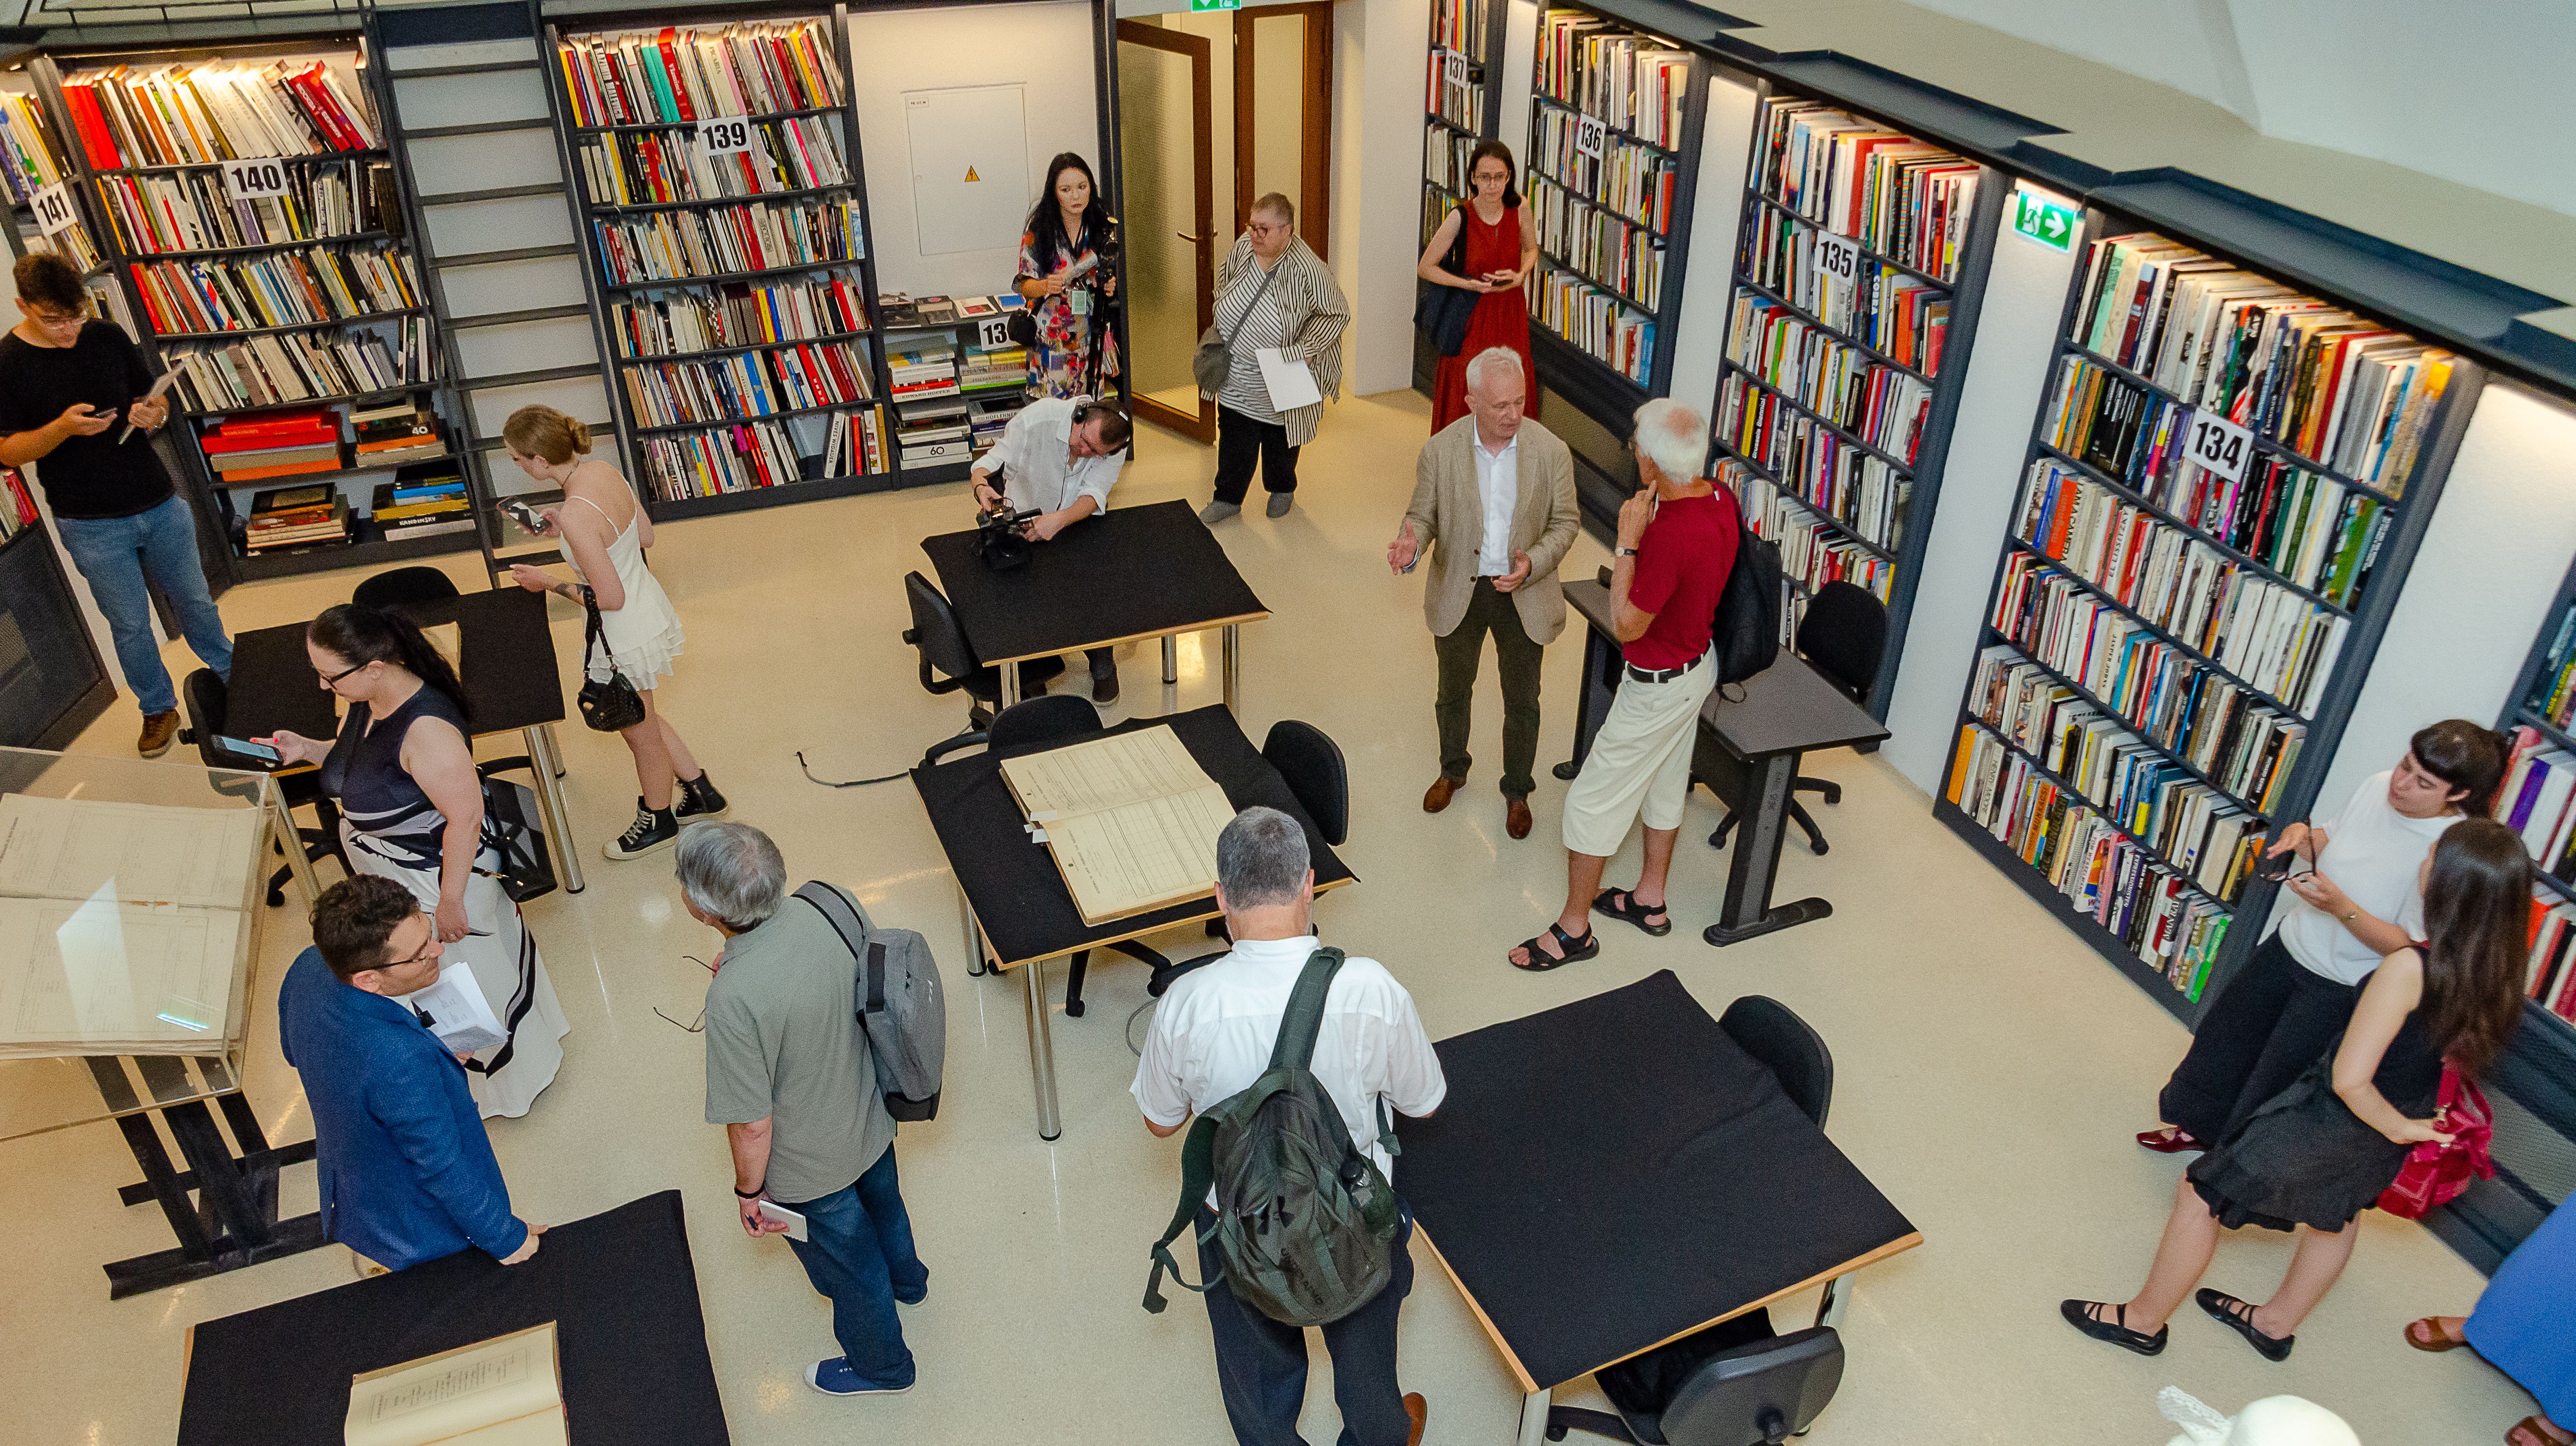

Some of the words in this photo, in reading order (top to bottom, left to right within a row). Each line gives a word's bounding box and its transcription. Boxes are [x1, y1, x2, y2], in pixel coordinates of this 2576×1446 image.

[709, 47, 721, 74] PICABIA
[1448, 55, 1465, 78] 137
[606, 82, 624, 119] MALEVICH
[703, 122, 747, 151] 139
[1580, 122, 1602, 151] 136
[231, 161, 281, 192] 140
[38, 191, 71, 226] 141
[1821, 241, 1852, 278] 135
[1871, 275, 1881, 316] COBRA
[1756, 398, 1766, 427] Biennial
[412, 426, 428, 435] 40
[828, 439, 837, 464] WIDAUER
[930, 446, 945, 456] 60
[2195, 422, 2244, 470] 134
[399, 516, 436, 526] KANDINSKY
[2060, 515, 2077, 561] CAMERA
[2108, 565, 2116, 578] EL
[2112, 512, 2129, 563] LISSITZKY
[2107, 634, 2117, 662] JASPER
[2102, 662, 2111, 687] JOHNS
[1988, 760, 1997, 787] HENRY
[1983, 788, 1992, 815] MOORE
[2089, 837, 2097, 850] TOM
[2123, 854, 2141, 907] EXPRESSIONISTEN
